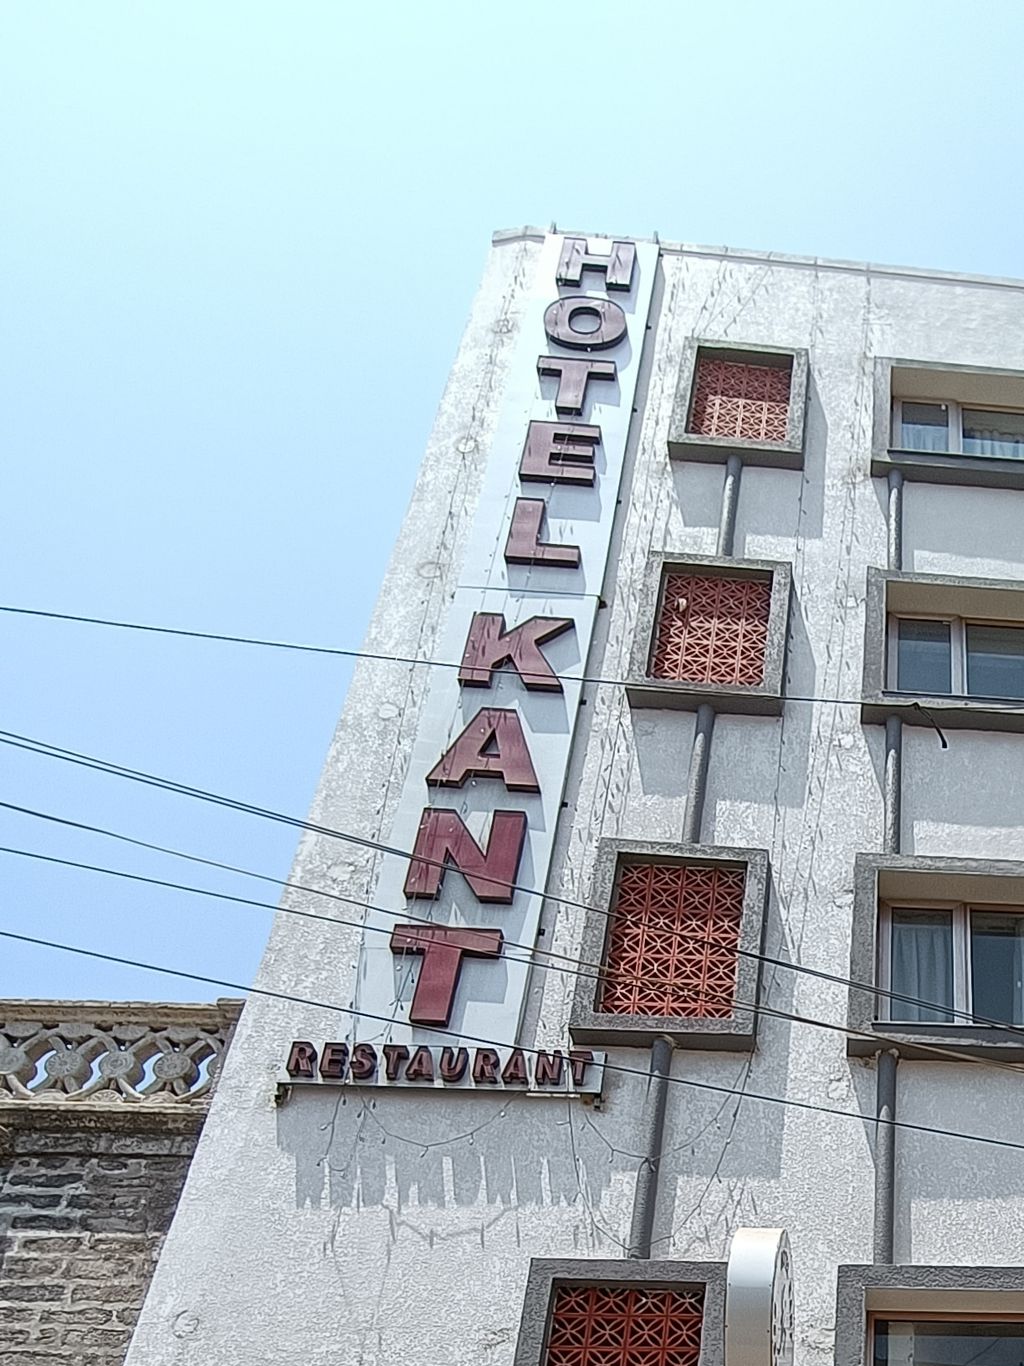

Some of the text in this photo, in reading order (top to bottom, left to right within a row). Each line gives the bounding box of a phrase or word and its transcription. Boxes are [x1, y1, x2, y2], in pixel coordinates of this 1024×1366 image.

[390, 237, 637, 1026] HOTEL KANT
[286, 1041, 595, 1086] RESTAURANT
